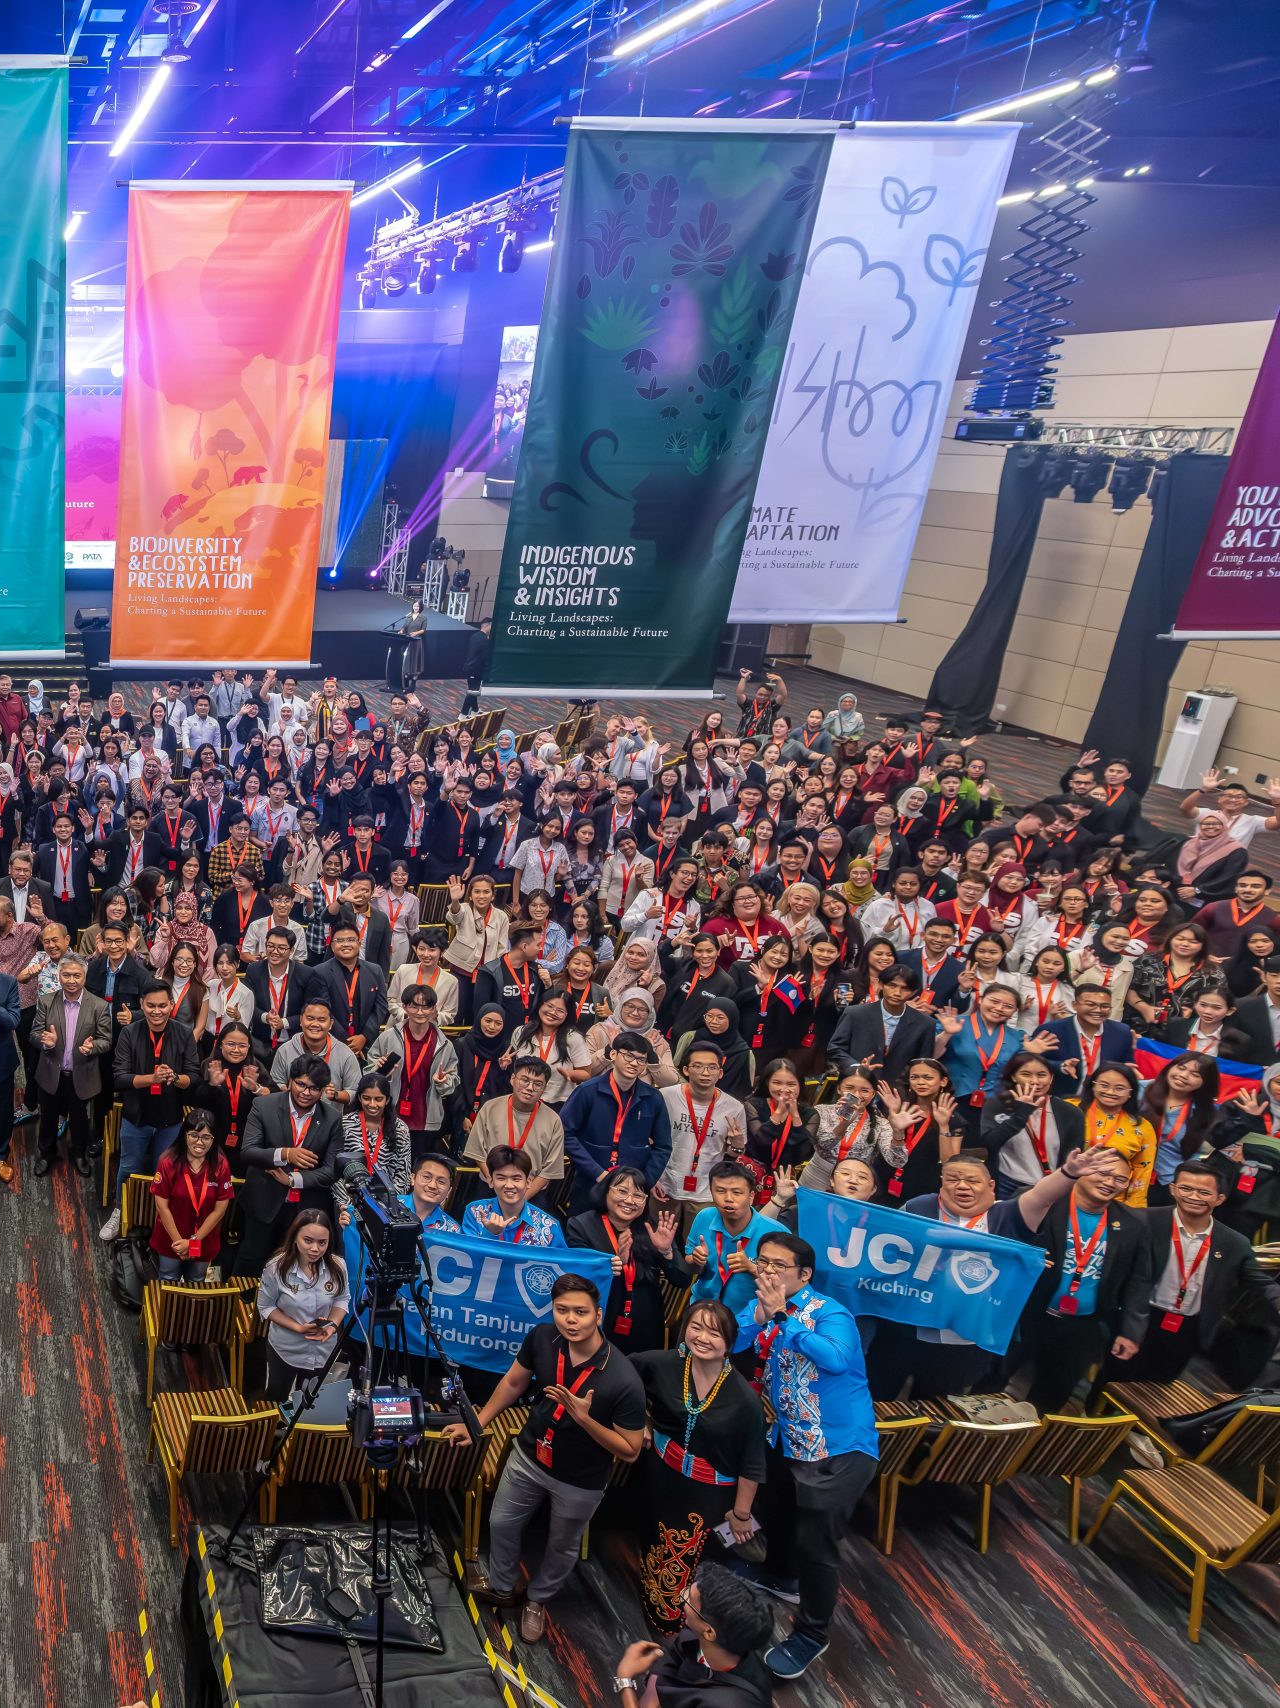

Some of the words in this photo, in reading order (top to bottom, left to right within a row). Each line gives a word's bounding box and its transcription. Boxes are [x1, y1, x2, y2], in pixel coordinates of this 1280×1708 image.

[1236, 486, 1280, 506] YOU
[65, 501, 95, 509] uture
[750, 507, 799, 522] MATE
[746, 525, 840, 541] APTATION
[1220, 529, 1236, 548] &
[129, 536, 243, 554] BIODIVERSITY
[755, 547, 813, 558] Landscapes:
[520, 545, 636, 566] INDIGENOUS
[1212, 552, 1245, 565] Living
[770, 560, 826, 569] Sustainable
[829, 560, 860, 569] Future
[127, 571, 253, 589] PRESERVATION
[519, 566, 597, 586] WISDOM
[1207, 567, 1254, 580] Charting
[128, 594, 158, 604] Living
[161, 594, 217, 606] Landscapes:
[514, 587, 531, 606] &
[534, 587, 620, 607] INSIGHTS
[127, 606, 168, 617] Charting
[179, 607, 232, 616] Sustainable
[236, 607, 267, 616] Future
[509, 611, 546, 625] Living
[549, 612, 614, 625] Landscapes:
[507, 625, 557, 640] Charting
[568, 627, 629, 637] Sustainable
[632, 627, 669, 637] Future
[827, 1227, 943, 1283] JCI
[420, 1245, 503, 1303] CI
[857, 1277, 934, 1304] Kuching
[461, 1306, 537, 1334] Tanjun
